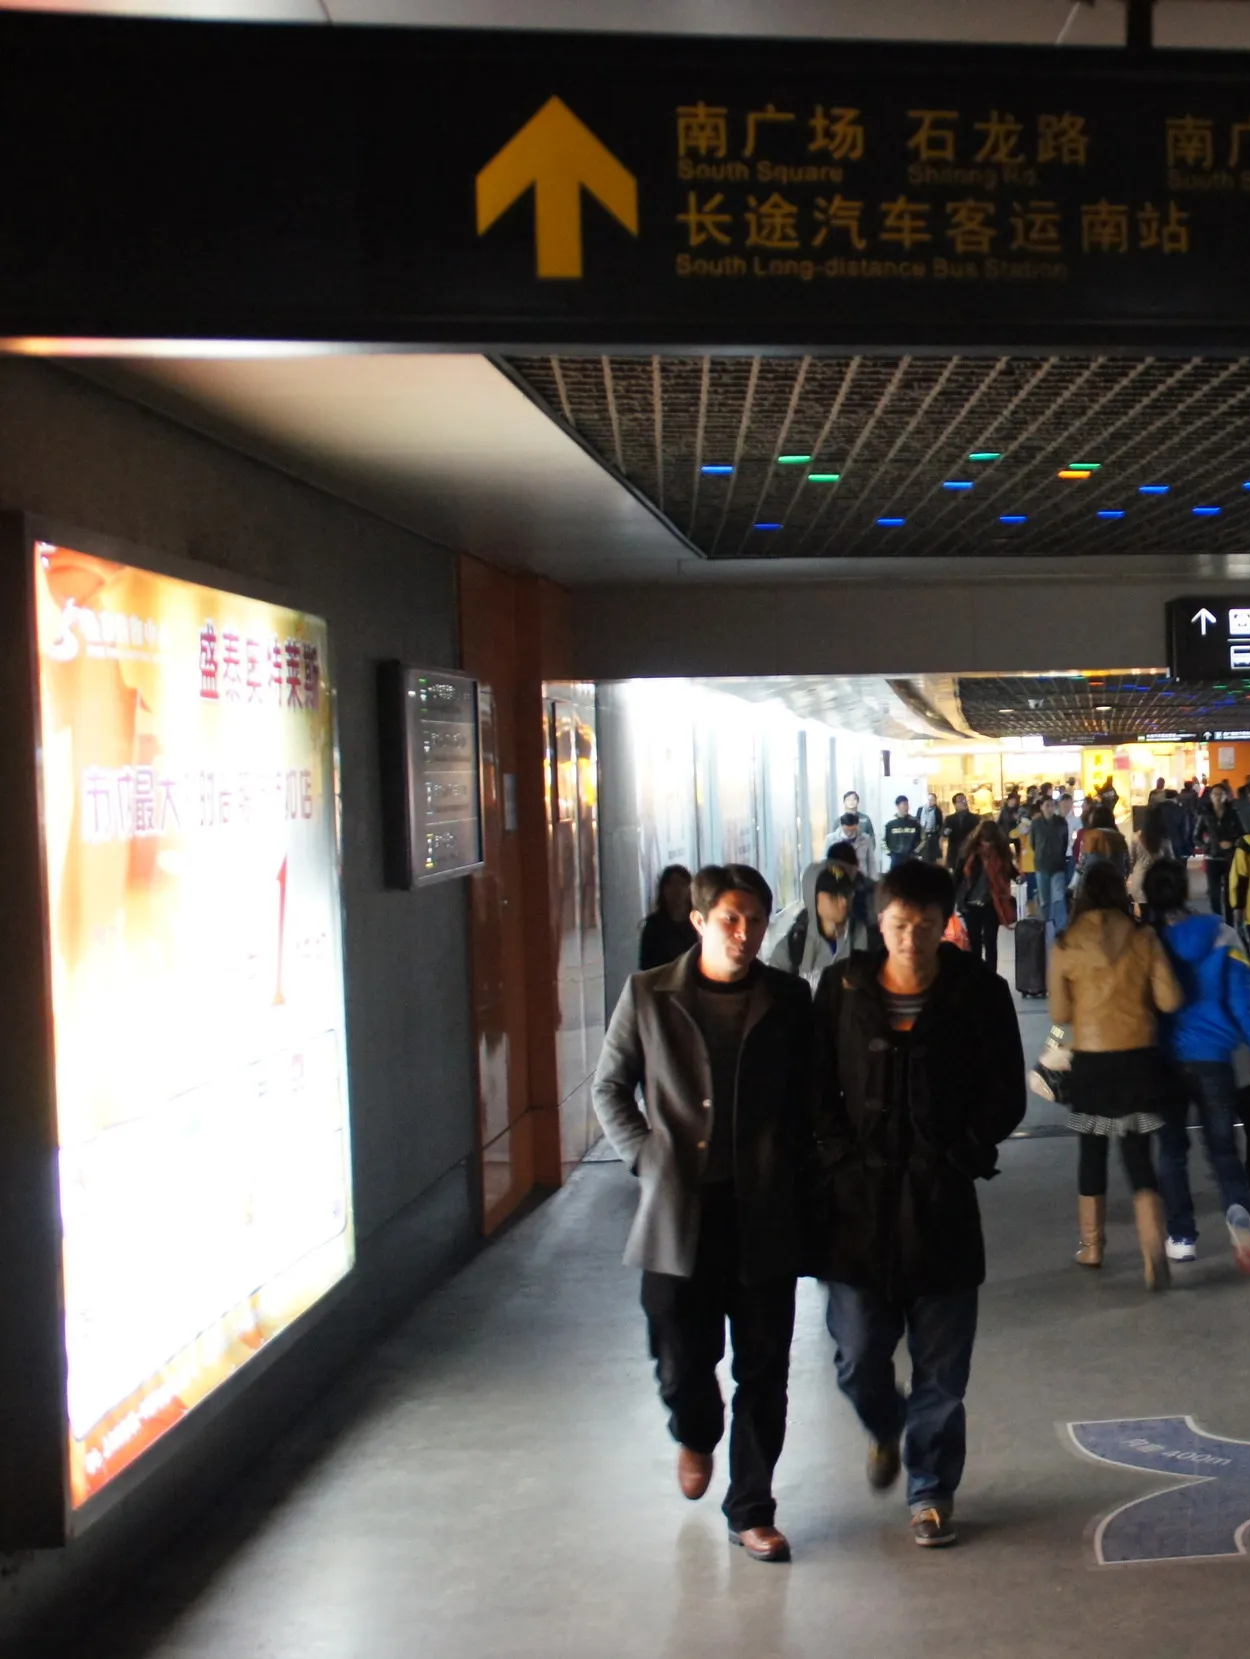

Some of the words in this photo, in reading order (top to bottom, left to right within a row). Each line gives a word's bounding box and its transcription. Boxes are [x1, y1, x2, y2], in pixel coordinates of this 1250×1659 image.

[675, 102, 867, 160] 南广场
[906, 109, 1091, 166] 石龙路
[676, 157, 749, 182] South
[756, 159, 845, 184] Square
[676, 191, 1191, 254] 长途汽车客运南站
[676, 252, 747, 277] South
[754, 254, 926, 279] Long-distance
[932, 255, 979, 279] Bus
